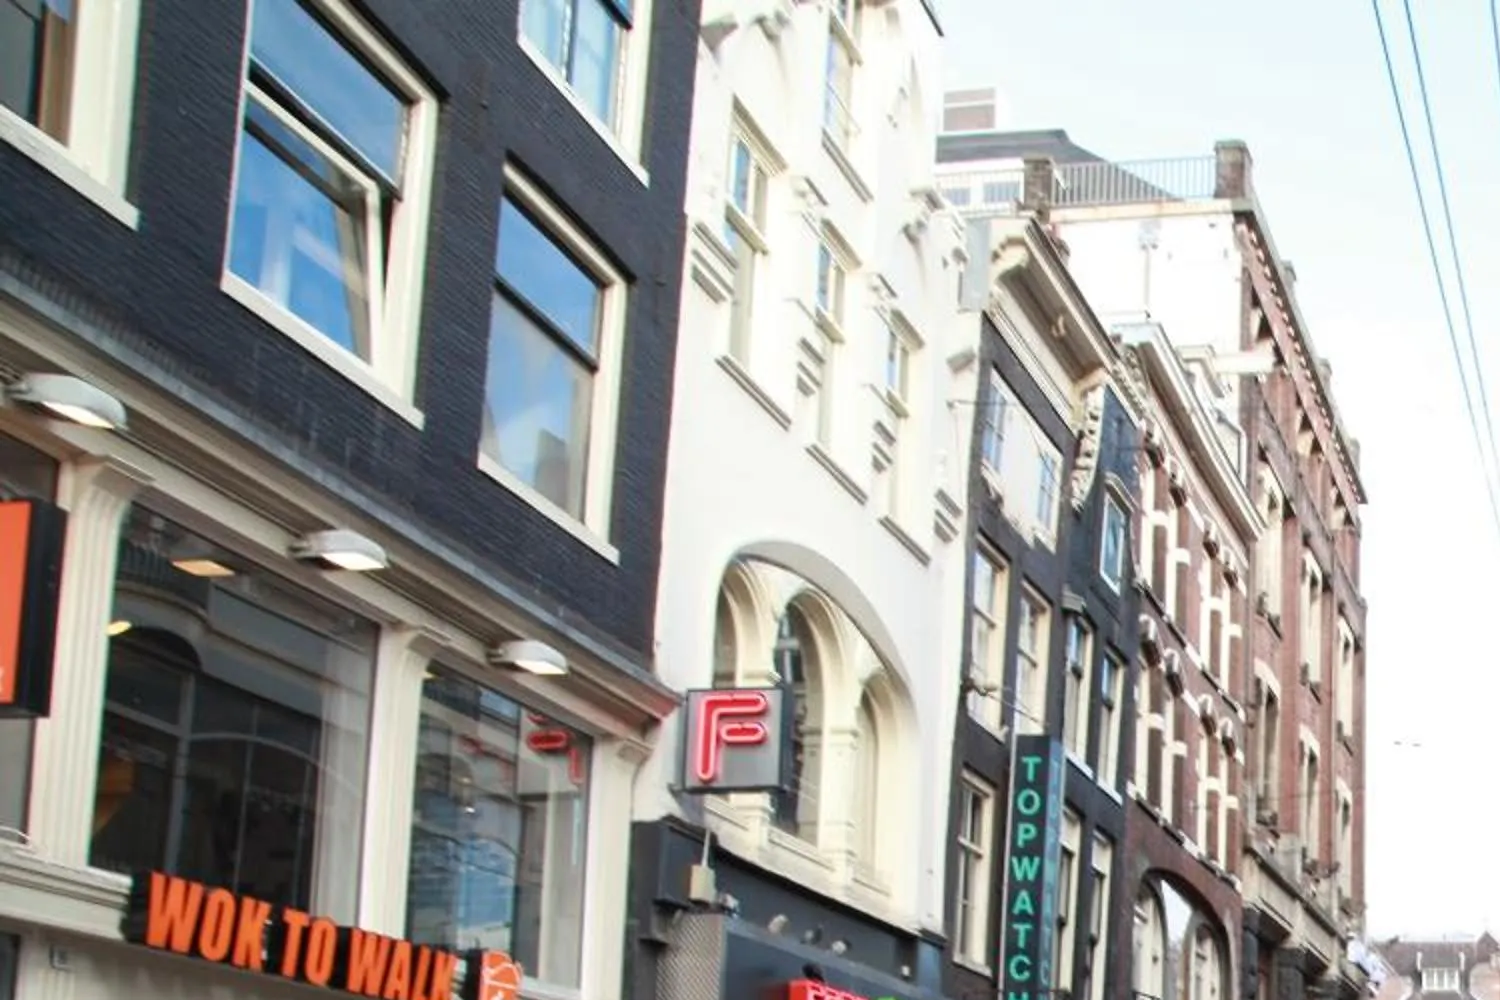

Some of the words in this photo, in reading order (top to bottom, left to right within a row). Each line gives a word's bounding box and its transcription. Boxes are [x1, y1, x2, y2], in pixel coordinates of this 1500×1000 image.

[696, 692, 768, 783] F
[145, 870, 272, 974] WOK
[280, 907, 338, 987] TO
